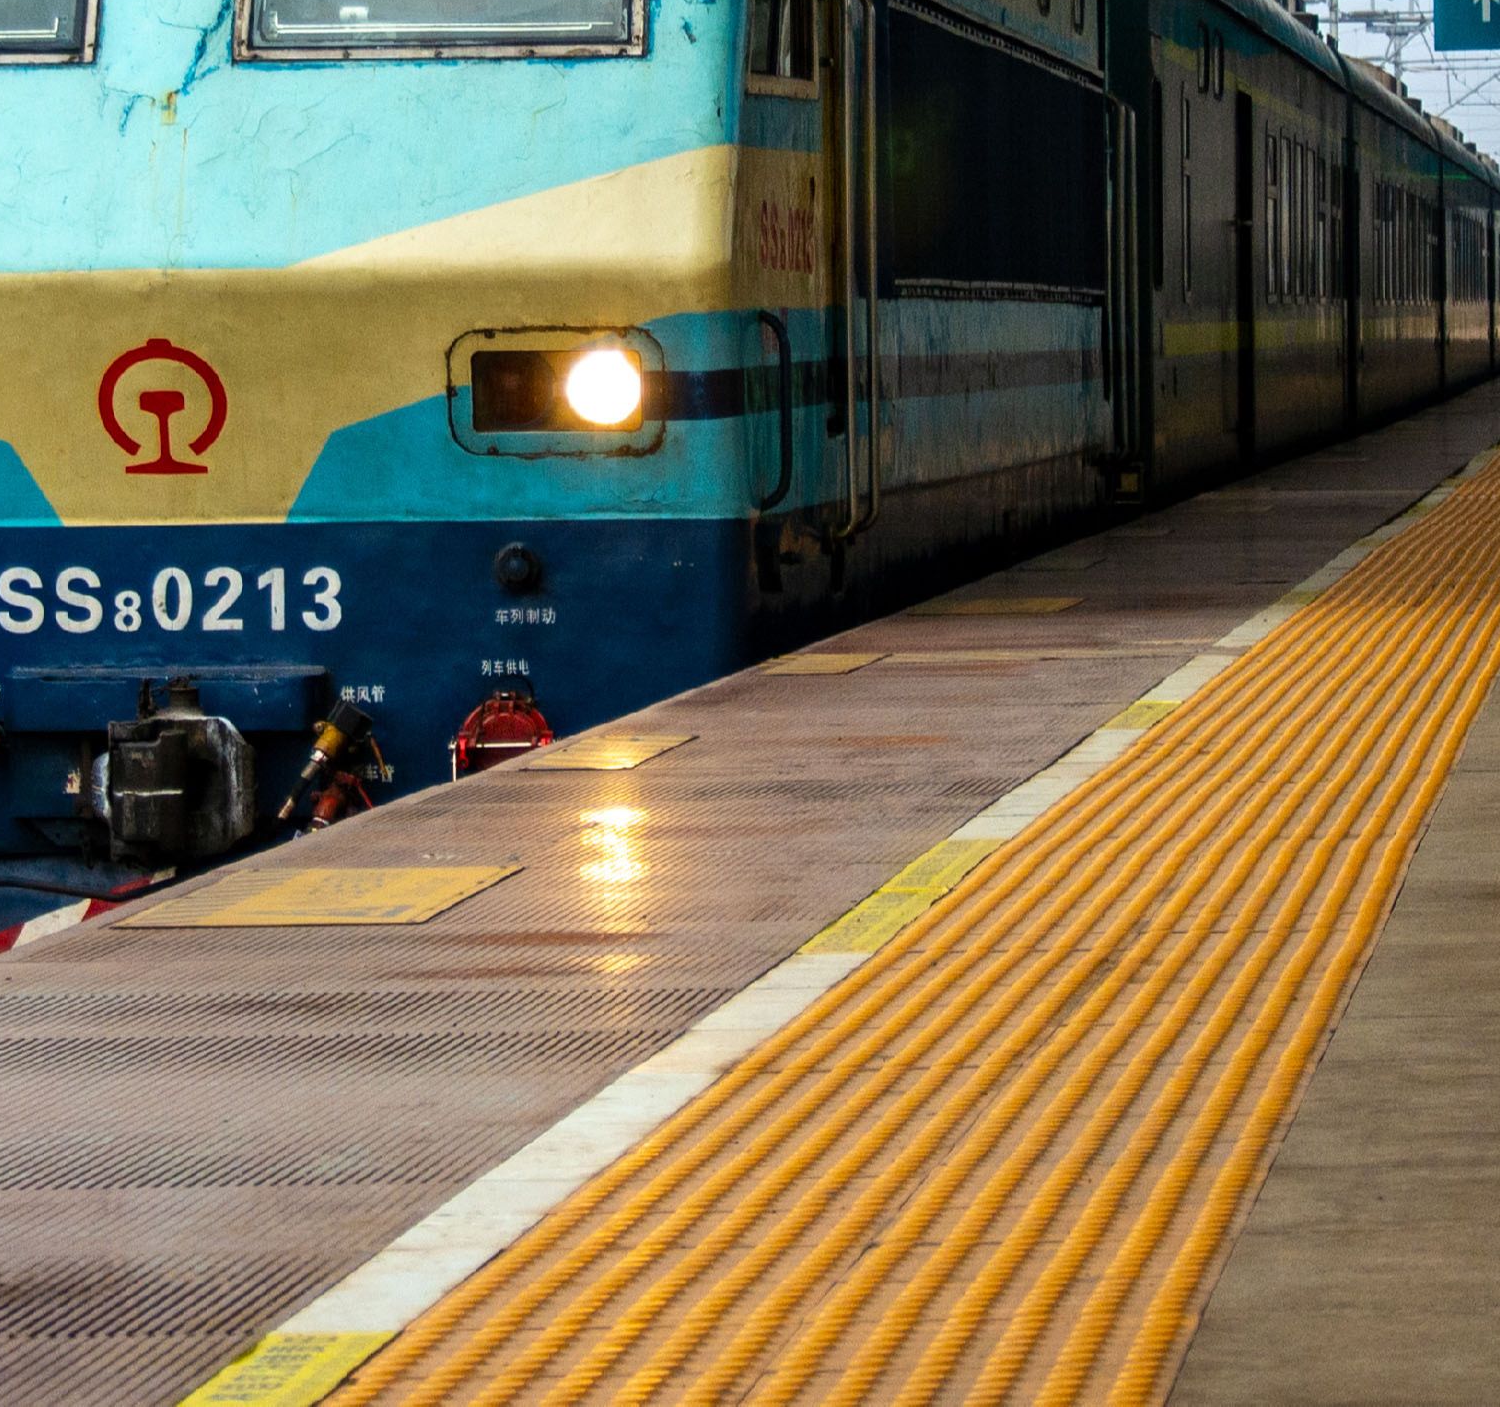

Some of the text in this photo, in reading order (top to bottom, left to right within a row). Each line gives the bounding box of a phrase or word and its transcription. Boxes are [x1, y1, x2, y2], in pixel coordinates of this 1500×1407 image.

[495, 606, 556, 625] 车列制动
[481, 659, 530, 677] 列车供电
[340, 684, 386, 704] 供风管
